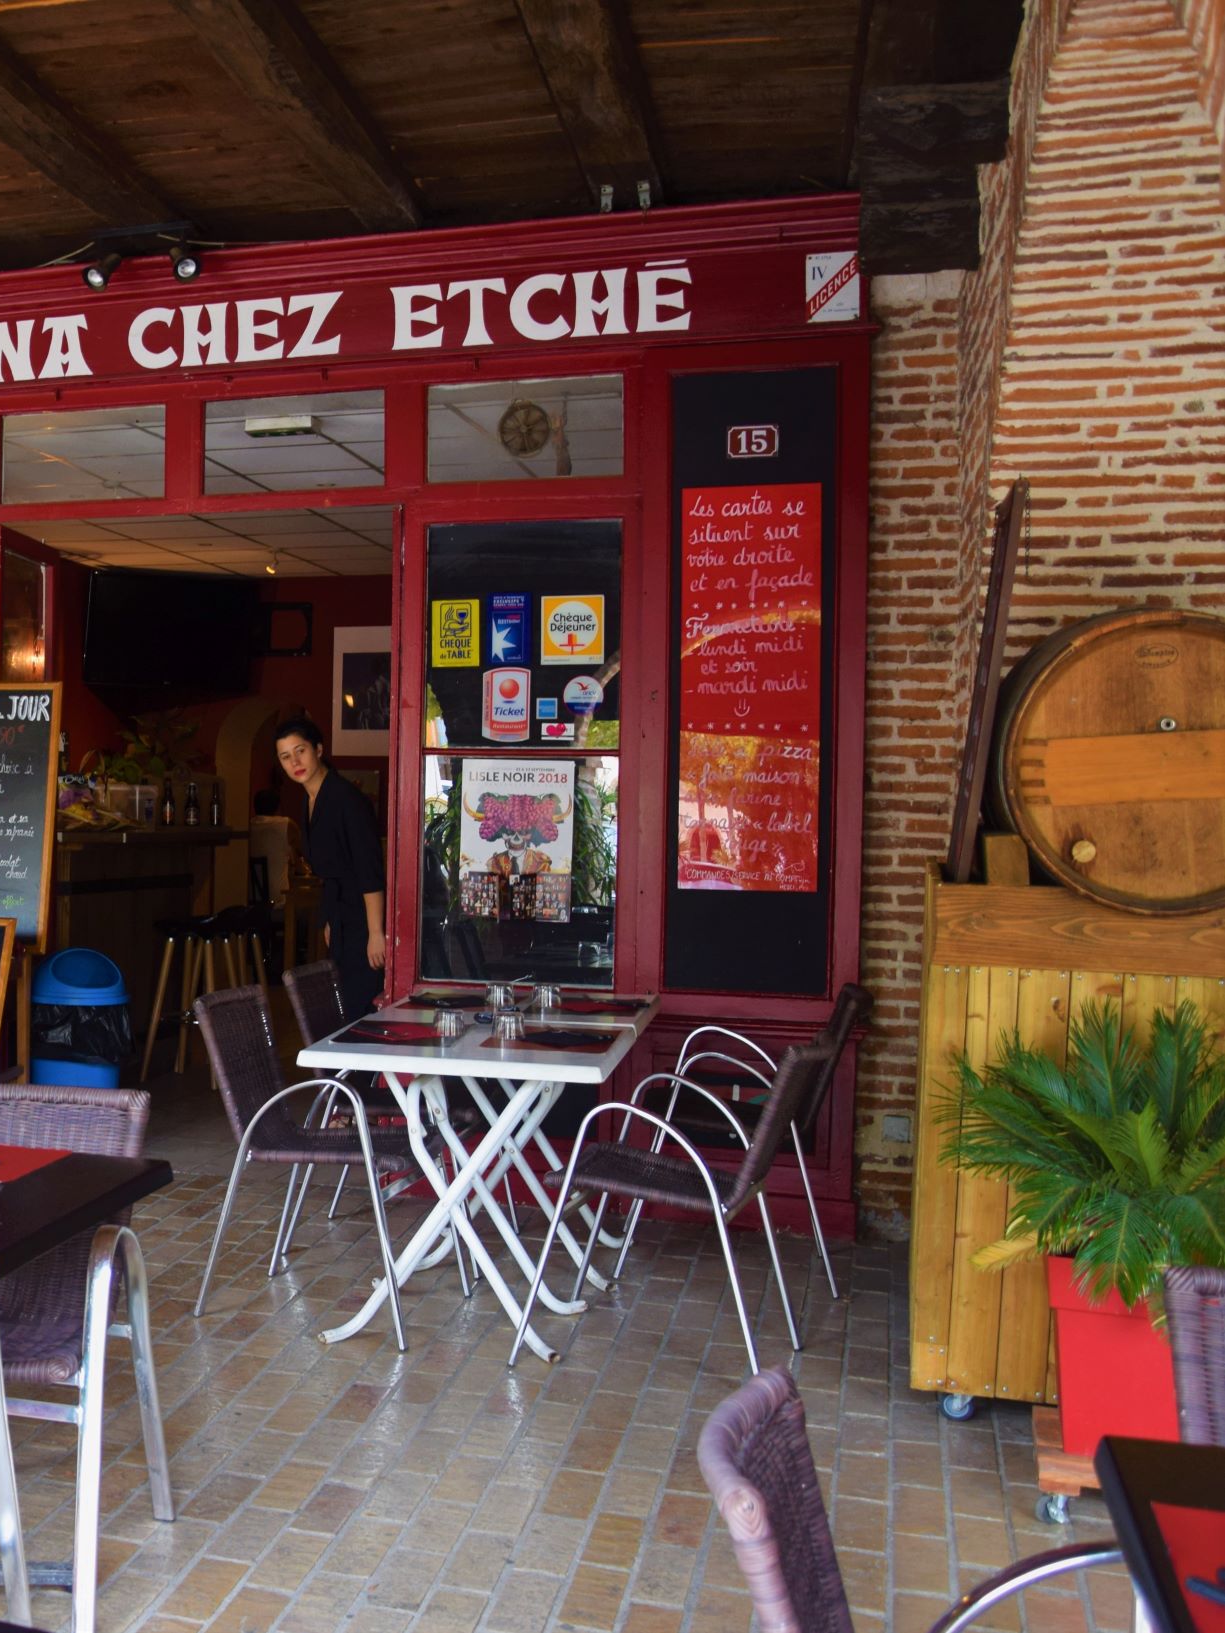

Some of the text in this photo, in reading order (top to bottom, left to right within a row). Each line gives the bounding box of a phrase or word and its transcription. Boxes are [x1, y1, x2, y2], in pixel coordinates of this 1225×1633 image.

[812, 266, 827, 280] IV
[810, 259, 856, 315] LICENCE
[127, 291, 343, 369] CHEZ
[737, 430, 768, 454] 15
[689, 489, 806, 517] Les cartes se
[688, 521, 801, 545] situent sur
[732, 544, 795, 565] droite
[690, 565, 814, 601] et en façade
[550, 622, 596, 633] Déjeuner
[553, 612, 593, 625] Chèque
[685, 612, 796, 639] Fermeture
[447, 650, 471, 659] TABLE
[698, 634, 804, 656] lundi midi
[700, 657, 758, 675] et soir
[698, 670, 808, 695] mardi midi
[6, 694, 50, 721] JOUR
[493, 706, 525, 716] Ticket
[757, 739, 812, 767] pizza
[469, 771, 568, 784] LISLE NOIR 2018
[743, 768, 800, 785] maison
